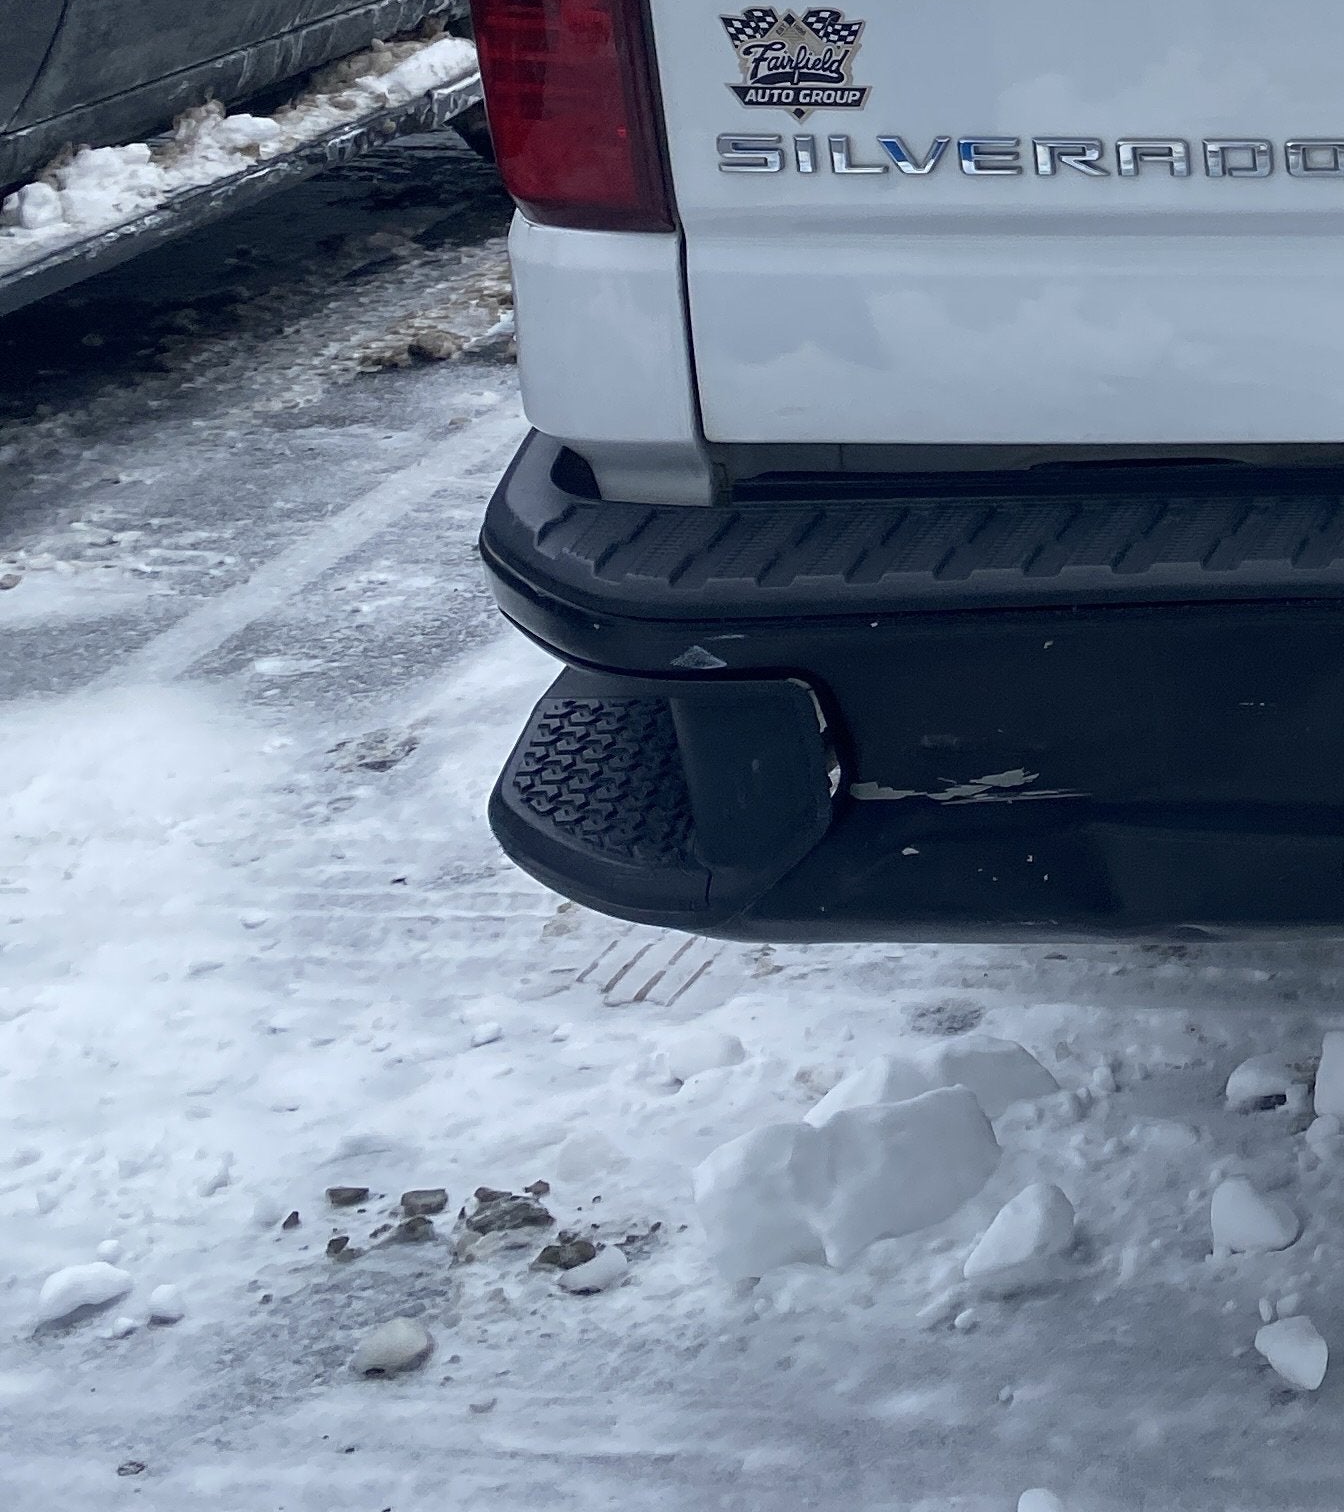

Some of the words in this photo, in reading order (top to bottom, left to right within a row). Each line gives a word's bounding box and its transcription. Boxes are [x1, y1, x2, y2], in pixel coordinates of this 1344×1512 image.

[742, 42, 849, 84] Fairfield
[745, 89, 794, 103] AUTO
[799, 89, 860, 104] GROUP
